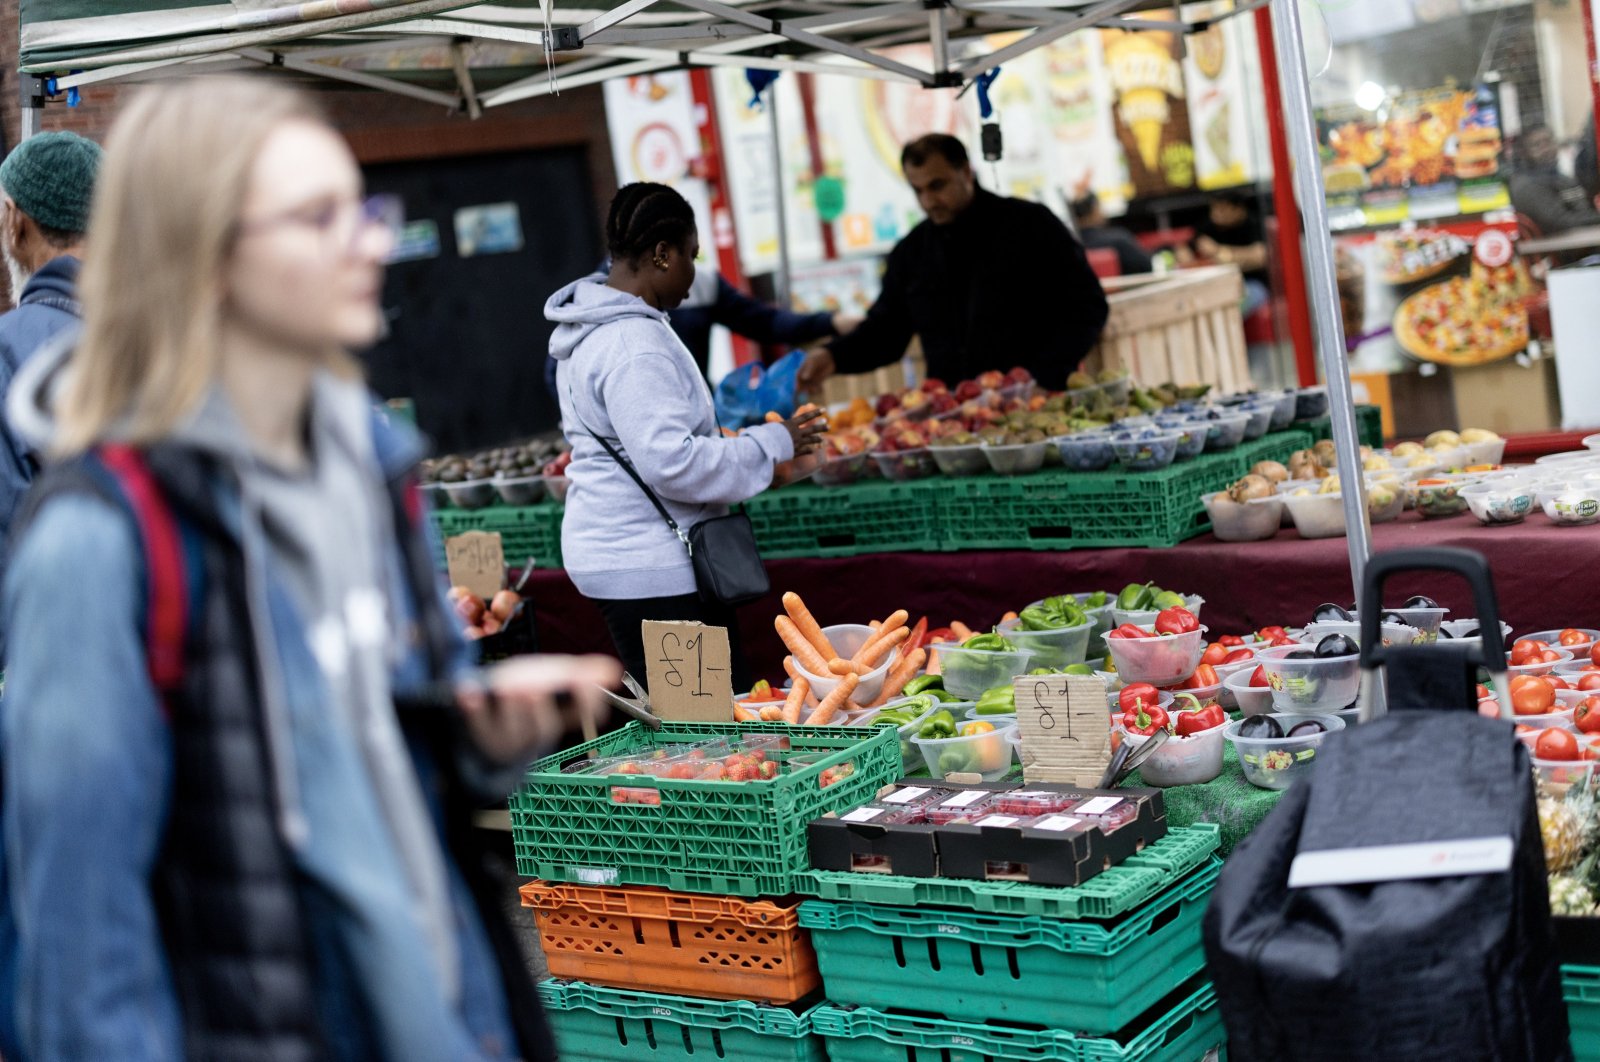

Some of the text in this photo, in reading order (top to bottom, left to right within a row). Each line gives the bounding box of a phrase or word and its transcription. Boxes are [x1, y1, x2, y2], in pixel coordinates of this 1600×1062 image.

[937, 924, 961, 934] IFCO
[652, 1007, 672, 1016] IFCO
[951, 1035, 974, 1046] IFCO
